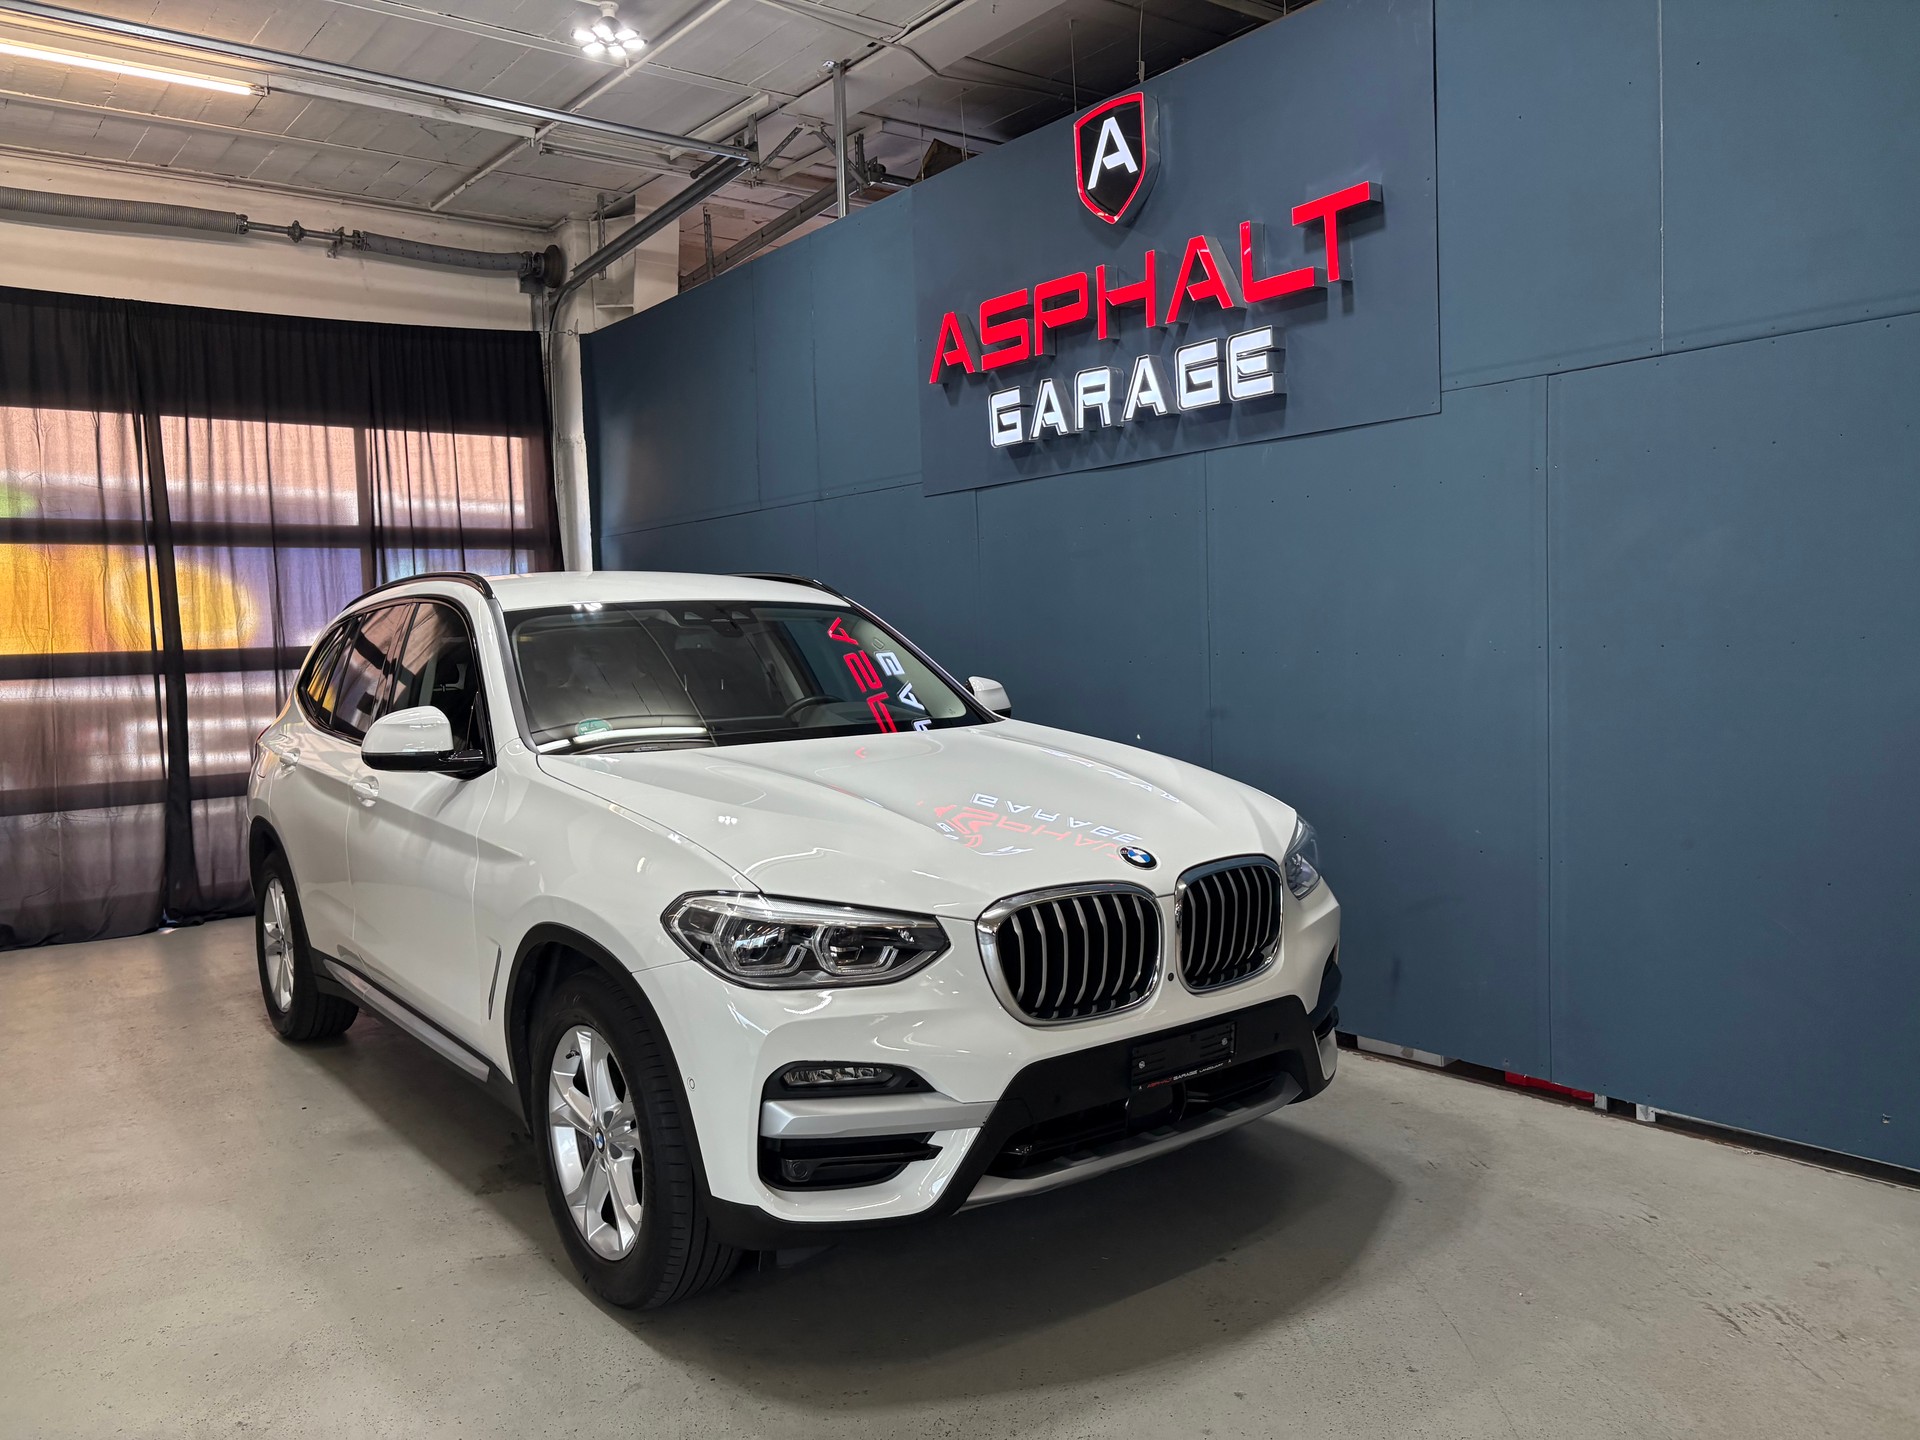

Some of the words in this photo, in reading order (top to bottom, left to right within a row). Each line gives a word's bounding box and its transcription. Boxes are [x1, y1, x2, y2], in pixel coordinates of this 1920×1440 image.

[1087, 116, 1139, 191] A
[928, 181, 1378, 385] ASPHALT
[987, 325, 1282, 450] GARAGE
[1173, 1069, 1198, 1081] GARAGE
